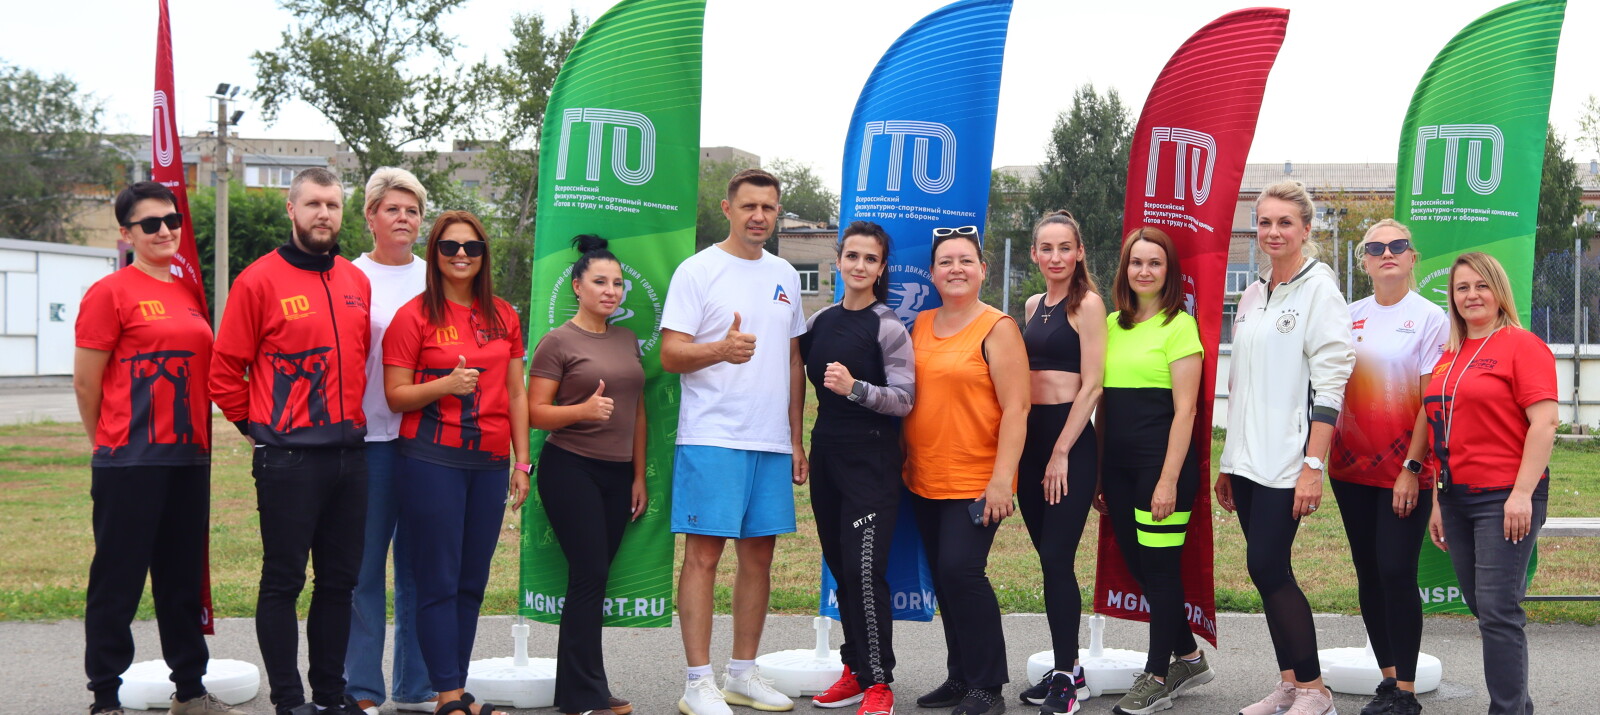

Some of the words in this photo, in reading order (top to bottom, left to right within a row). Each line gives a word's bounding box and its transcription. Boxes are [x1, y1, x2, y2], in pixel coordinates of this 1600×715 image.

[556, 107, 656, 186] ГТО
[857, 120, 957, 194] ГТО
[1412, 124, 1504, 195] ГТО
[1145, 127, 1216, 206] ГТО
[555, 185, 599, 193] Всероссийский
[554, 192, 641, 206] физкультурно-спортивный
[643, 201, 678, 211] комплекс
[577, 202, 597, 210] труду
[605, 204, 640, 214] обороне»
[1144, 201, 1184, 211] Всероссийский
[1411, 199, 1454, 207] Всероссийский
[854, 203, 941, 214] физкультурно-спортивный
[942, 209, 976, 218] комплекс
[877, 212, 897, 220] труду
[905, 212, 939, 221] обороне»
[1410, 207, 1491, 215] физкультурно-спортивный
[1491, 209, 1519, 217] комплекс
[1167, 219, 1183, 228] труду
[1459, 215, 1489, 223] обороне»
[905, 265, 932, 281] ДВИЖЕН
[621, 262, 641, 280] ЖЕНИЯ
[640, 279, 659, 302] ГОРОДА
[139, 300, 165, 316] ГТО
[280, 295, 309, 315] ГТО
[436, 326, 458, 343] ГТО
[525, 589, 665, 617] MGNSRT.RU
